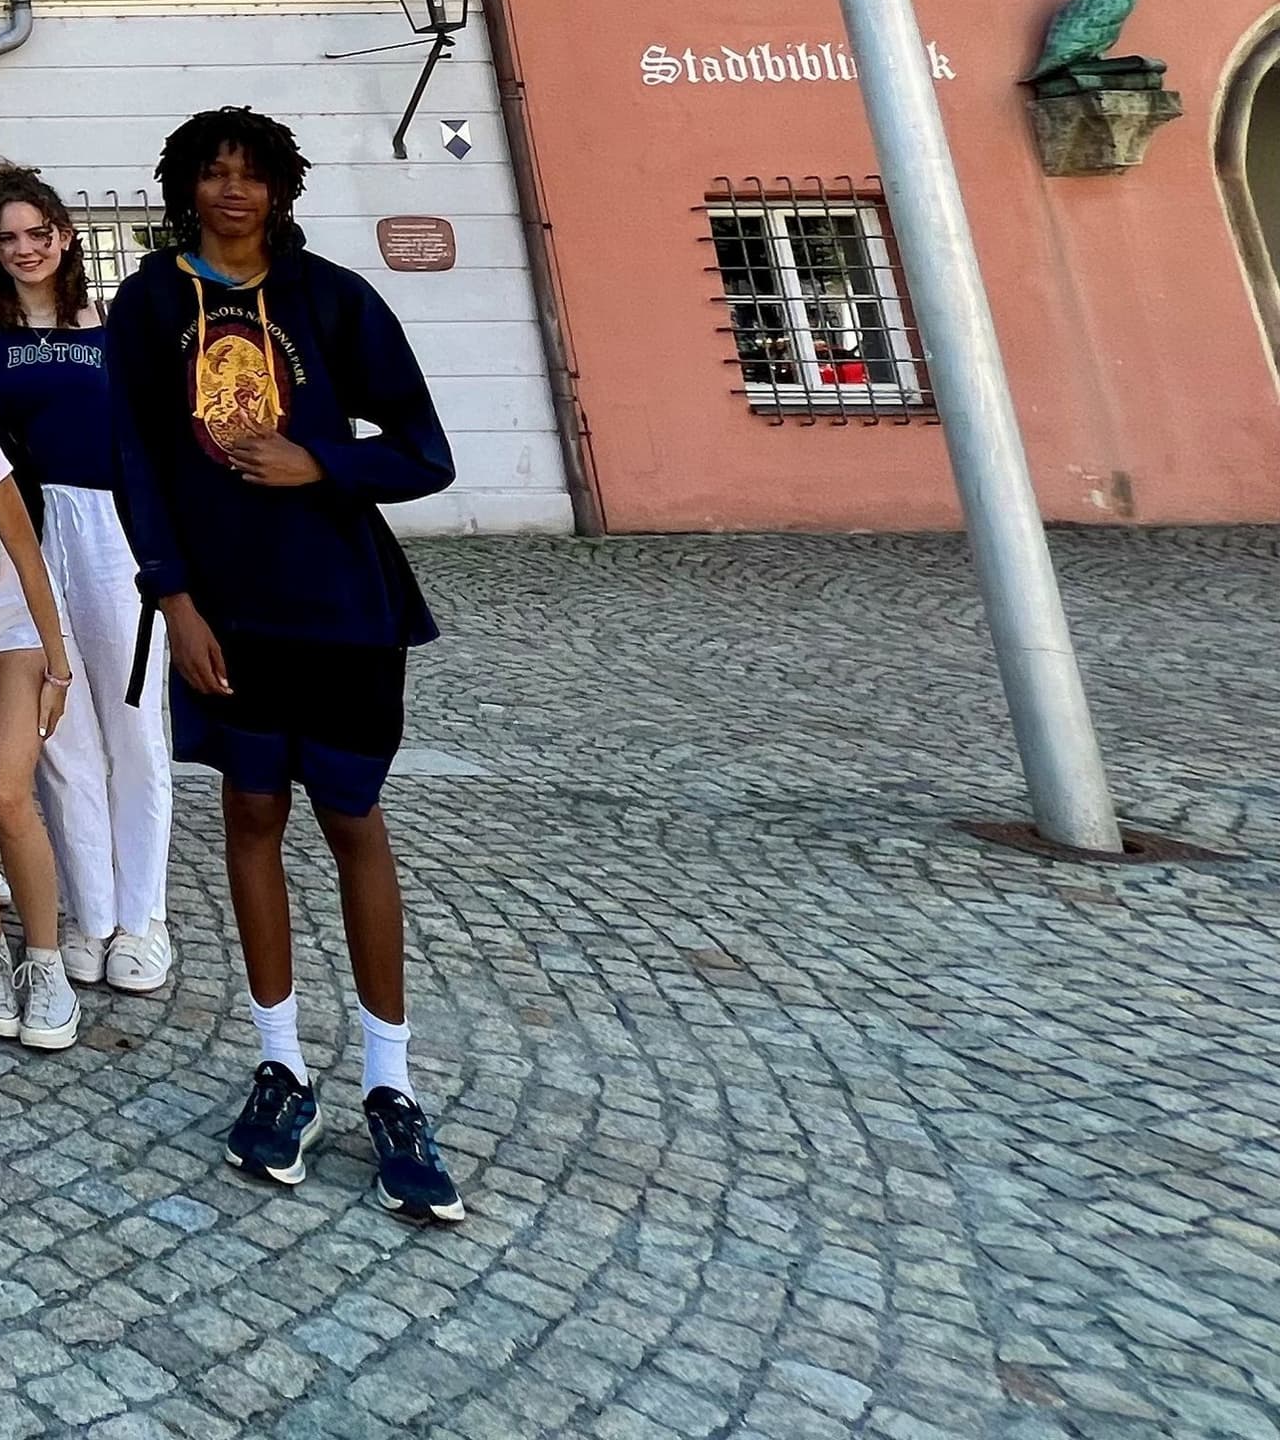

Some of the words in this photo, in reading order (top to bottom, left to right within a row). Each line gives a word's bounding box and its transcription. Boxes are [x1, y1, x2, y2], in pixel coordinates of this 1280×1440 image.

[640, 42, 957, 86] Stadtbiblik
[7, 342, 102, 368] BOSTON
[245, 310, 297, 357] NAIONAL
